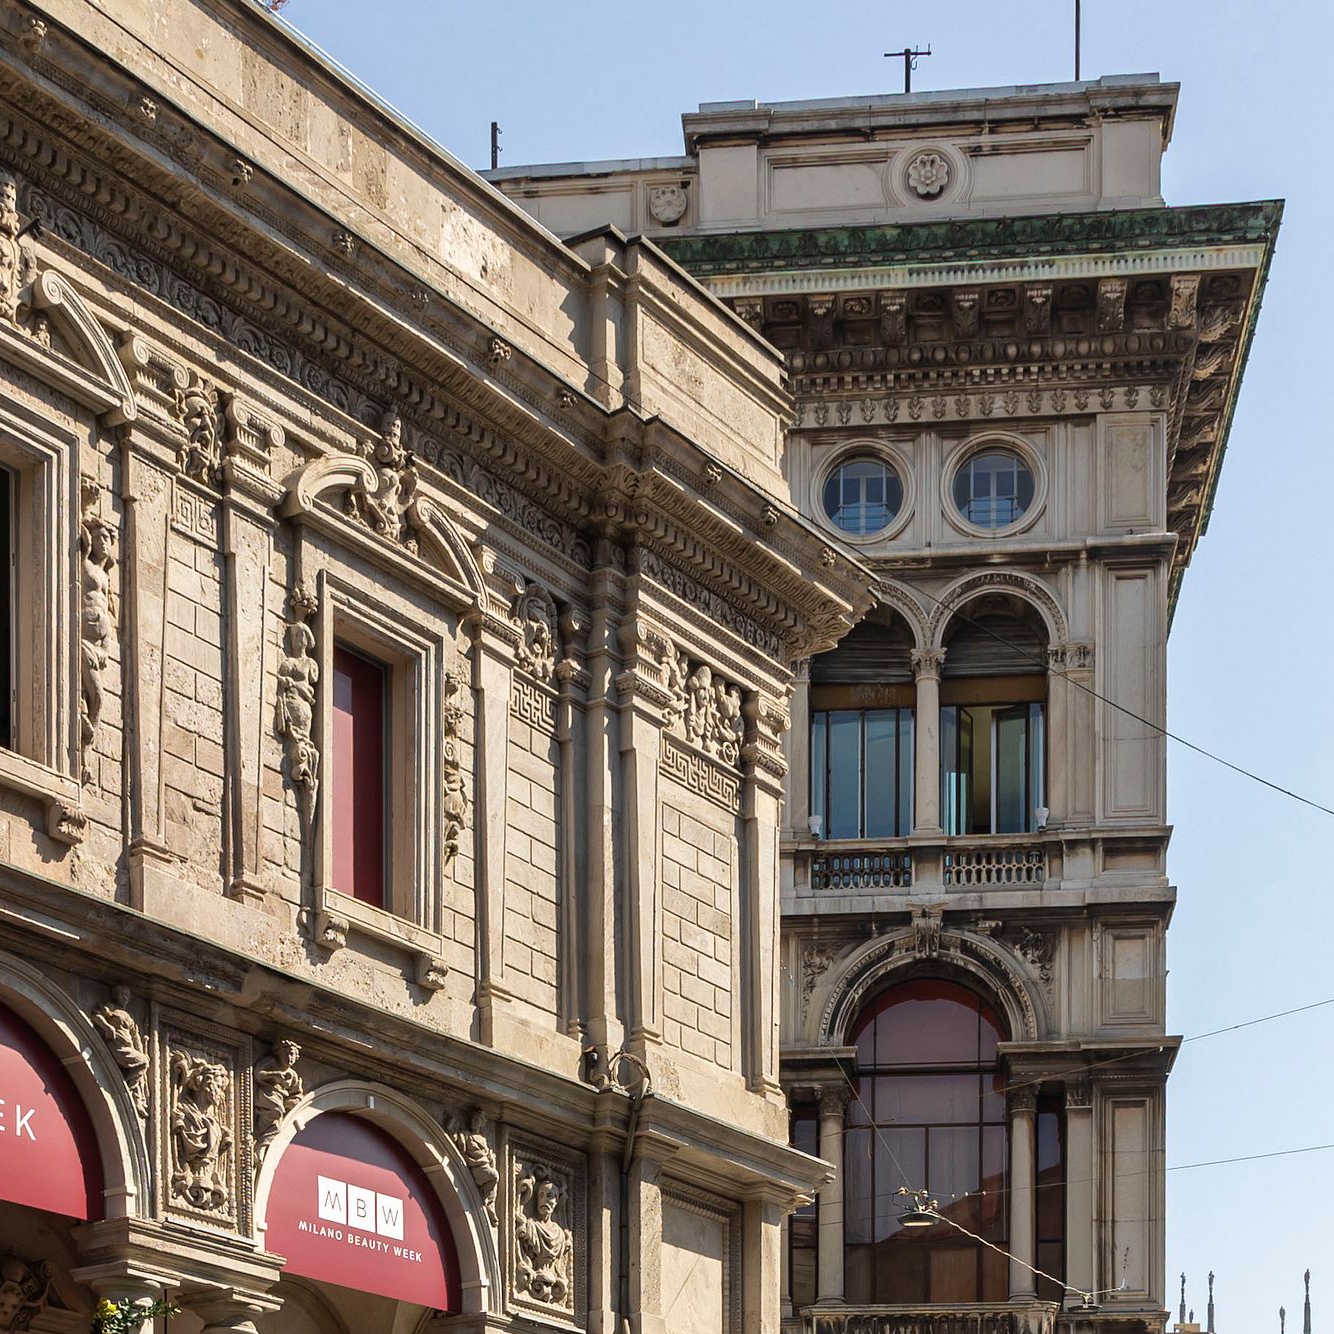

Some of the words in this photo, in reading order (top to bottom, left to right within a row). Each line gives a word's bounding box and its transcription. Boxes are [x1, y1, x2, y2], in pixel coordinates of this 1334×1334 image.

[324, 1189, 399, 1227] MBW
[298, 1220, 344, 1241] MILANO
[347, 1233, 390, 1254] BEAUTY
[393, 1246, 423, 1263] WEEK
